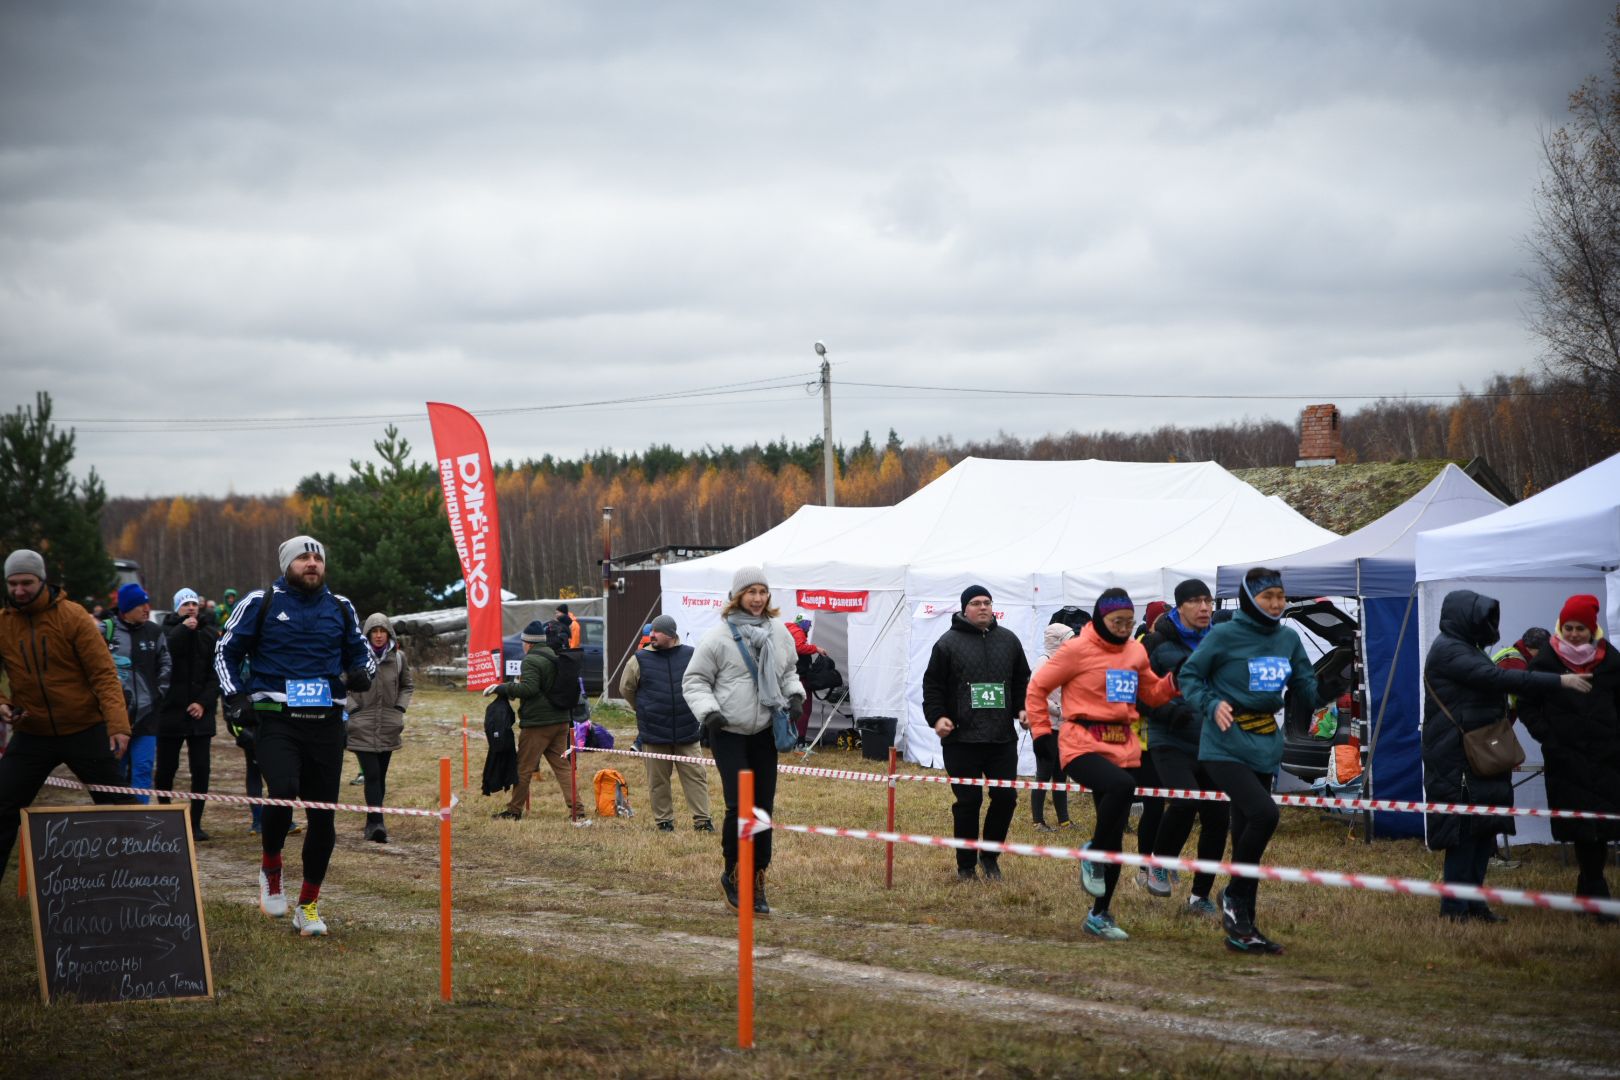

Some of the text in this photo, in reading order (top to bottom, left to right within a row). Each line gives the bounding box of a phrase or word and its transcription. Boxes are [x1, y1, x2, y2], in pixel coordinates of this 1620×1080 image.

[1259, 666, 1286, 681] 234
[296, 683, 324, 697] 257
[981, 690, 996, 701] 41
[1115, 680, 1135, 694] 223
[39, 816, 102, 866] Кофе
[41, 864, 181, 902] Горячий Шоколад
[46, 899, 195, 941] Какао Шоколад
[119, 973, 169, 999] Вода
